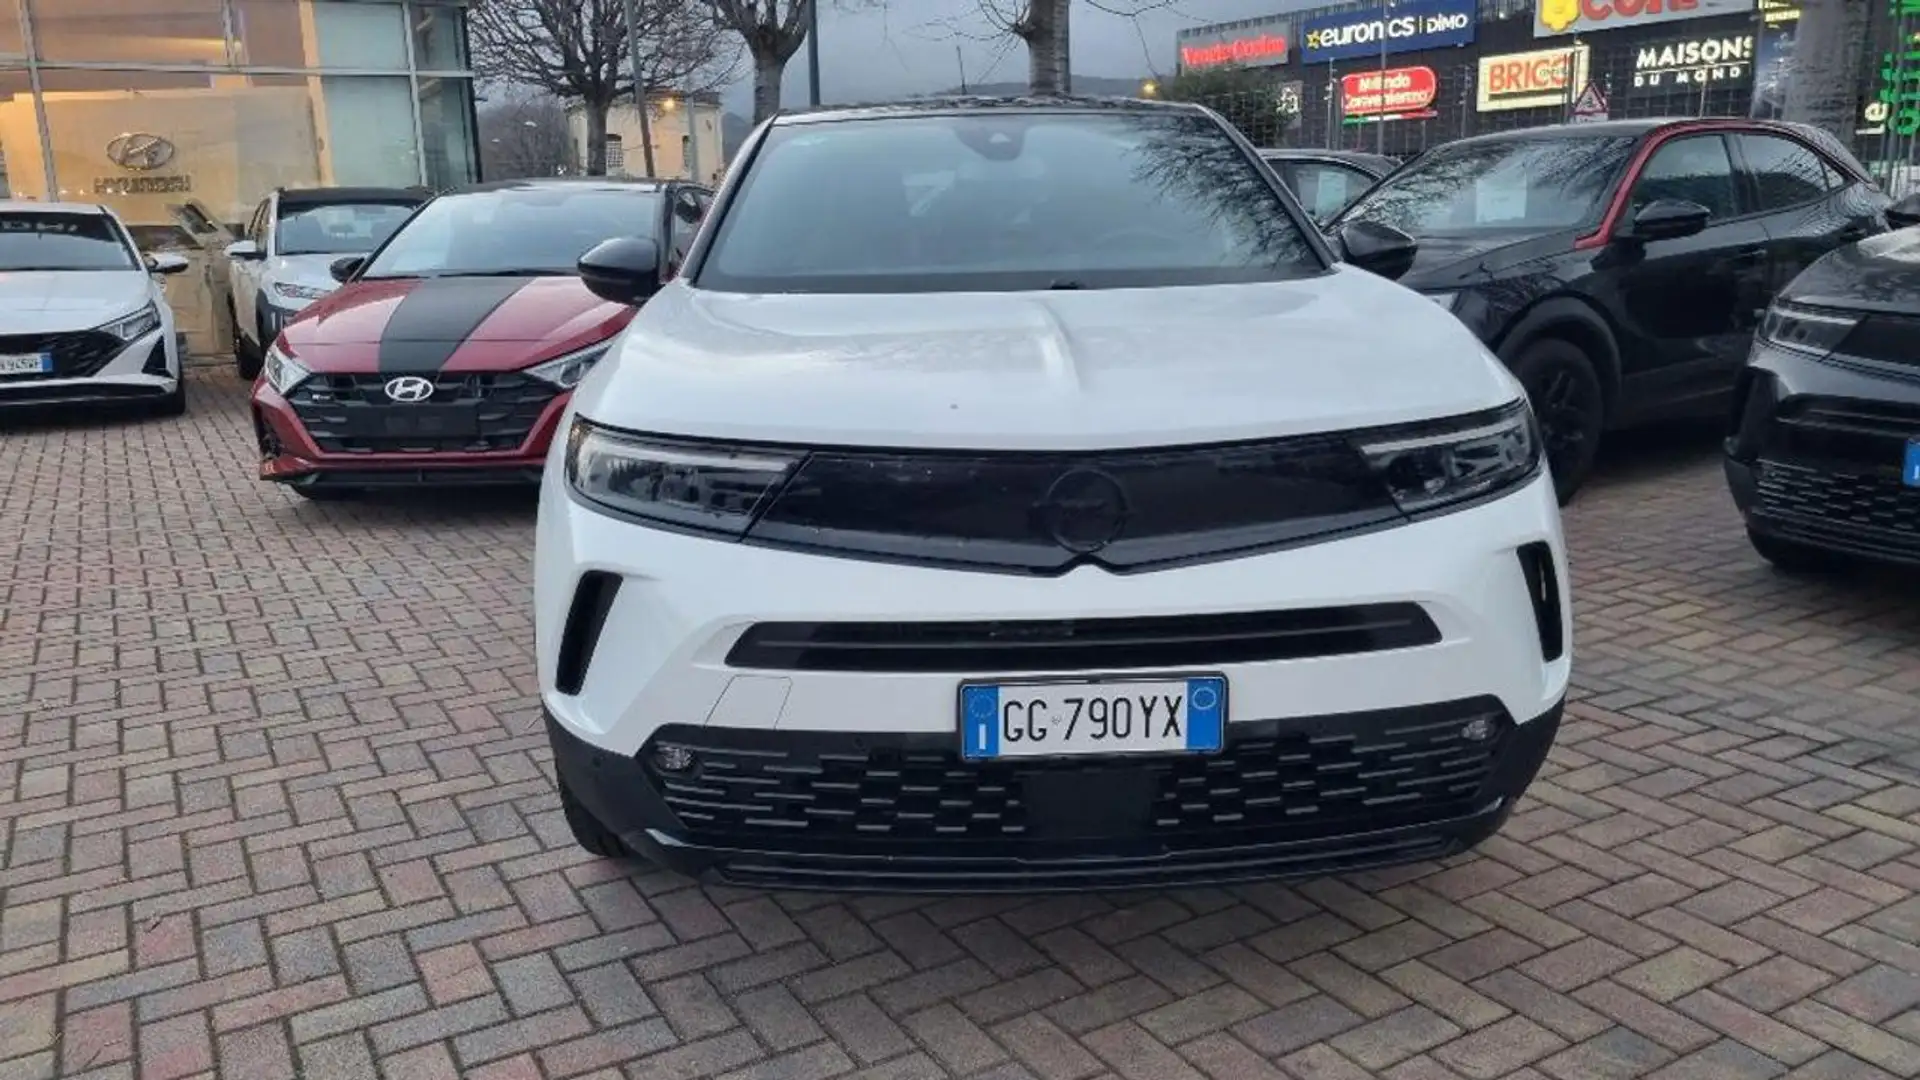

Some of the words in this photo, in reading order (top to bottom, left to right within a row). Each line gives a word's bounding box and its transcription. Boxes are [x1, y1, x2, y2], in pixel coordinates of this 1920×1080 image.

[1320, 17, 1415, 47] euroncs
[1634, 73, 1660, 87] DU
[1676, 66, 1742, 83] MOND
